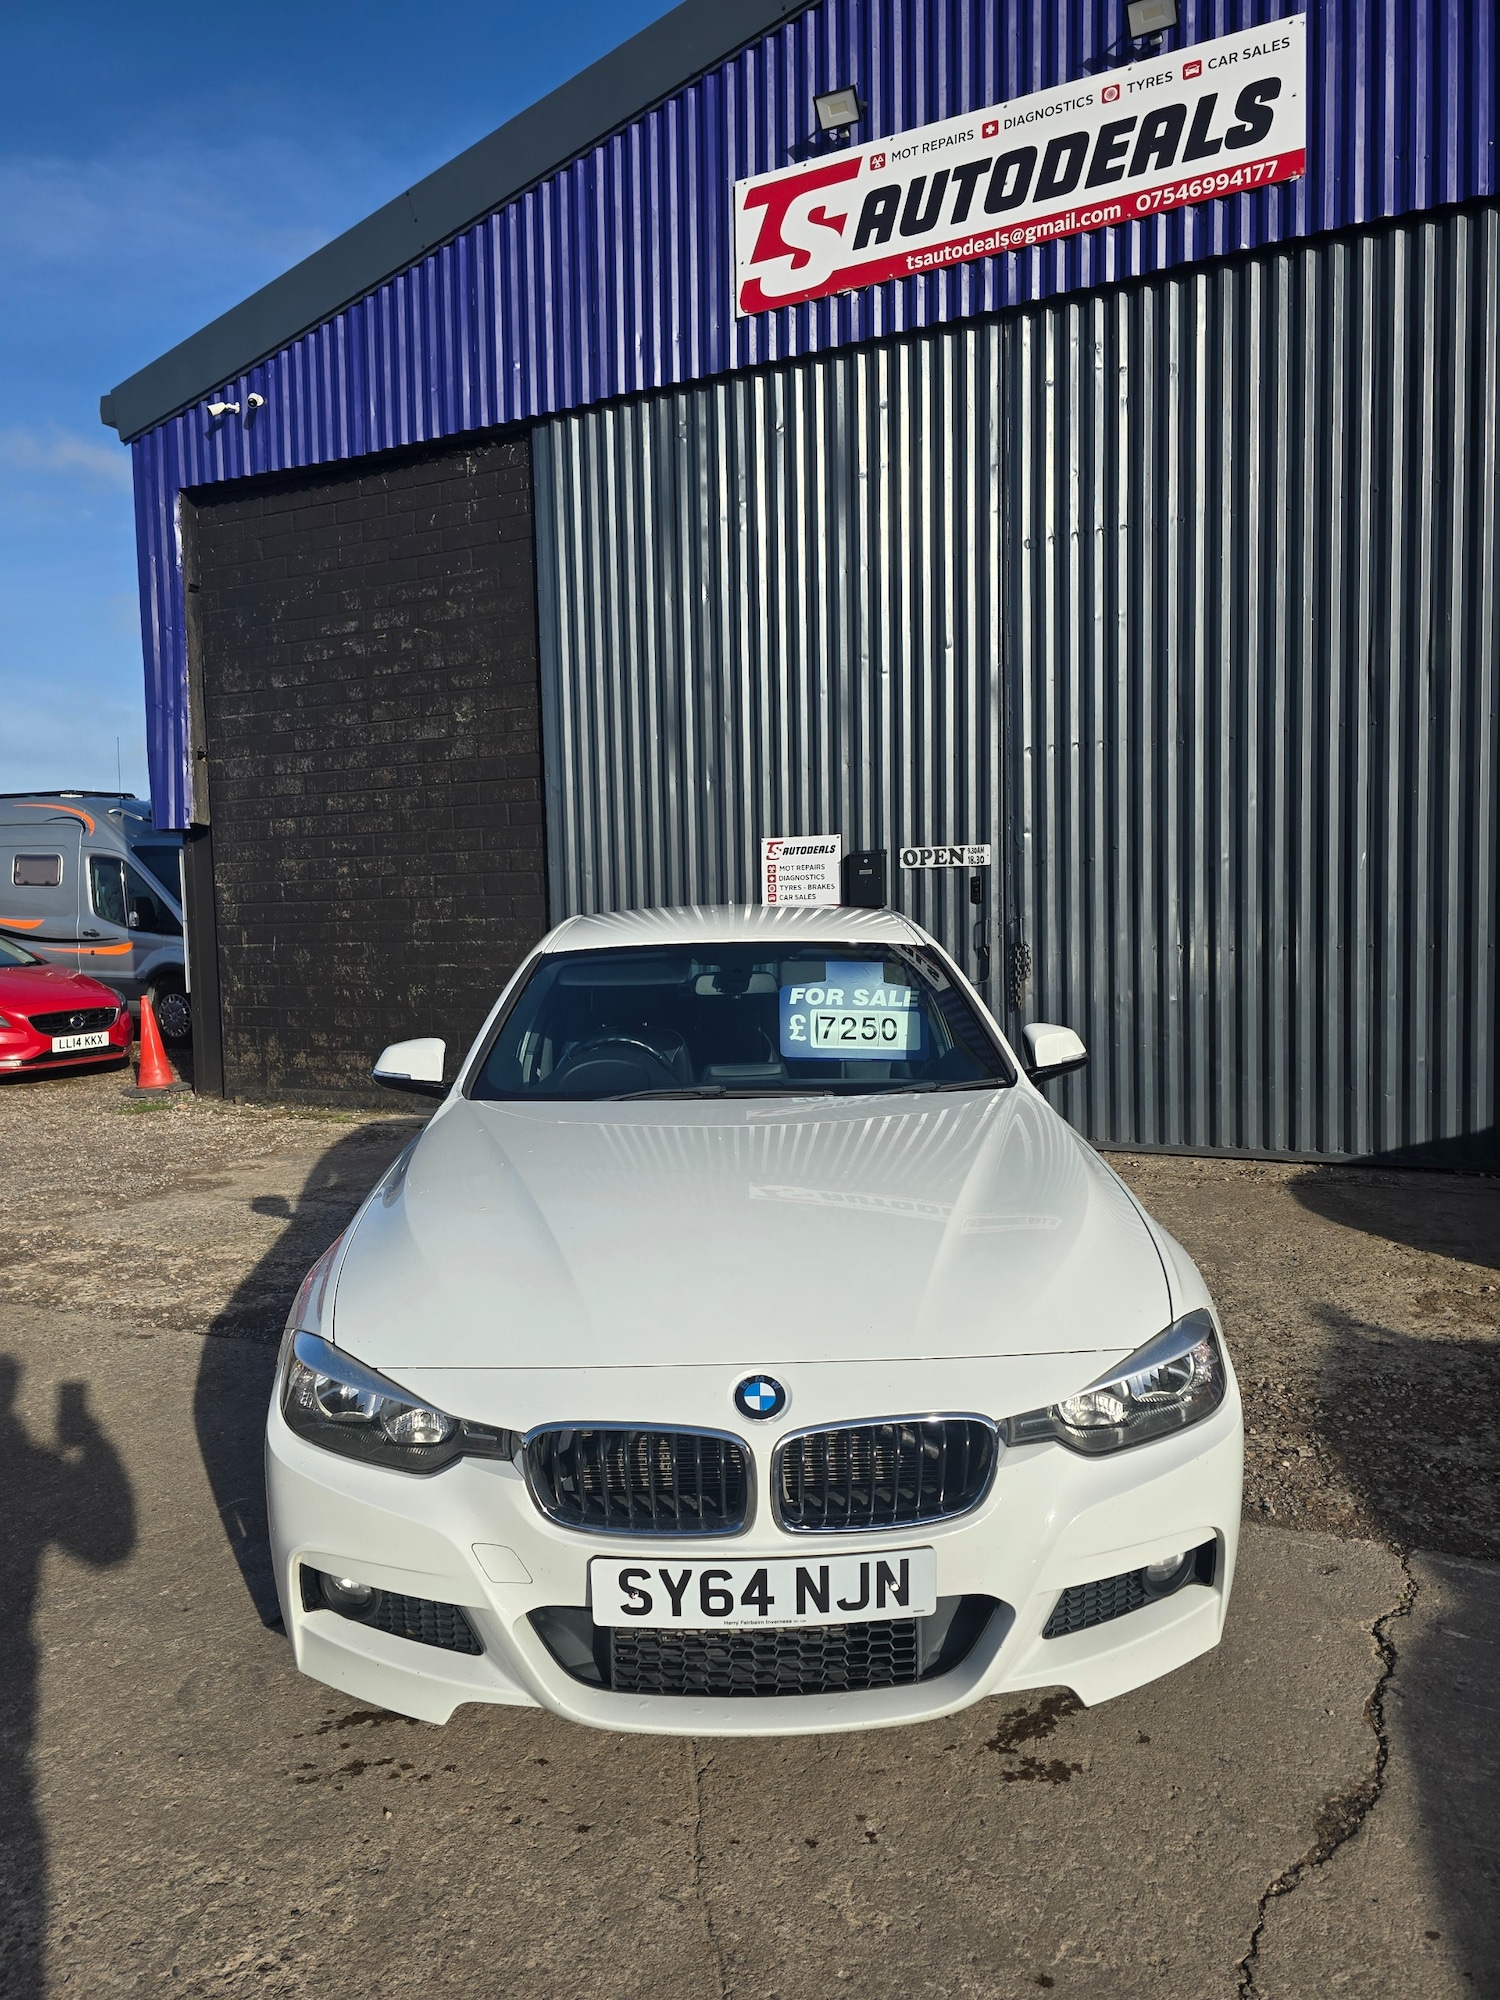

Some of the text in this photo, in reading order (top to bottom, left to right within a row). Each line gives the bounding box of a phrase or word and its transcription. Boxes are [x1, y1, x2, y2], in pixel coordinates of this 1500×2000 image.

[1207, 37, 1291, 70] CAR SALES
[1126, 71, 1174, 94] TYRES
[1003, 94, 1094, 130] DIAGNOSTICS
[890, 129, 975, 163] MOT REPAIRS
[852, 77, 1282, 250] AUTODEALS
[906, 160, 1278, 270] tsautodeals@gmail.com 07546994177
[782, 844, 836, 856] AUTODEALS
[902, 848, 965, 866] OPEN
[779, 874, 826, 882] DIAGNOSTICS
[789, 987, 920, 1008] FOR SALE
[819, 1017, 898, 1041] 7250
[58, 1034, 104, 1050] LL14 KKX
[740, 1376, 781, 1390] BMW
[618, 1558, 910, 1617] SY64 NJN
